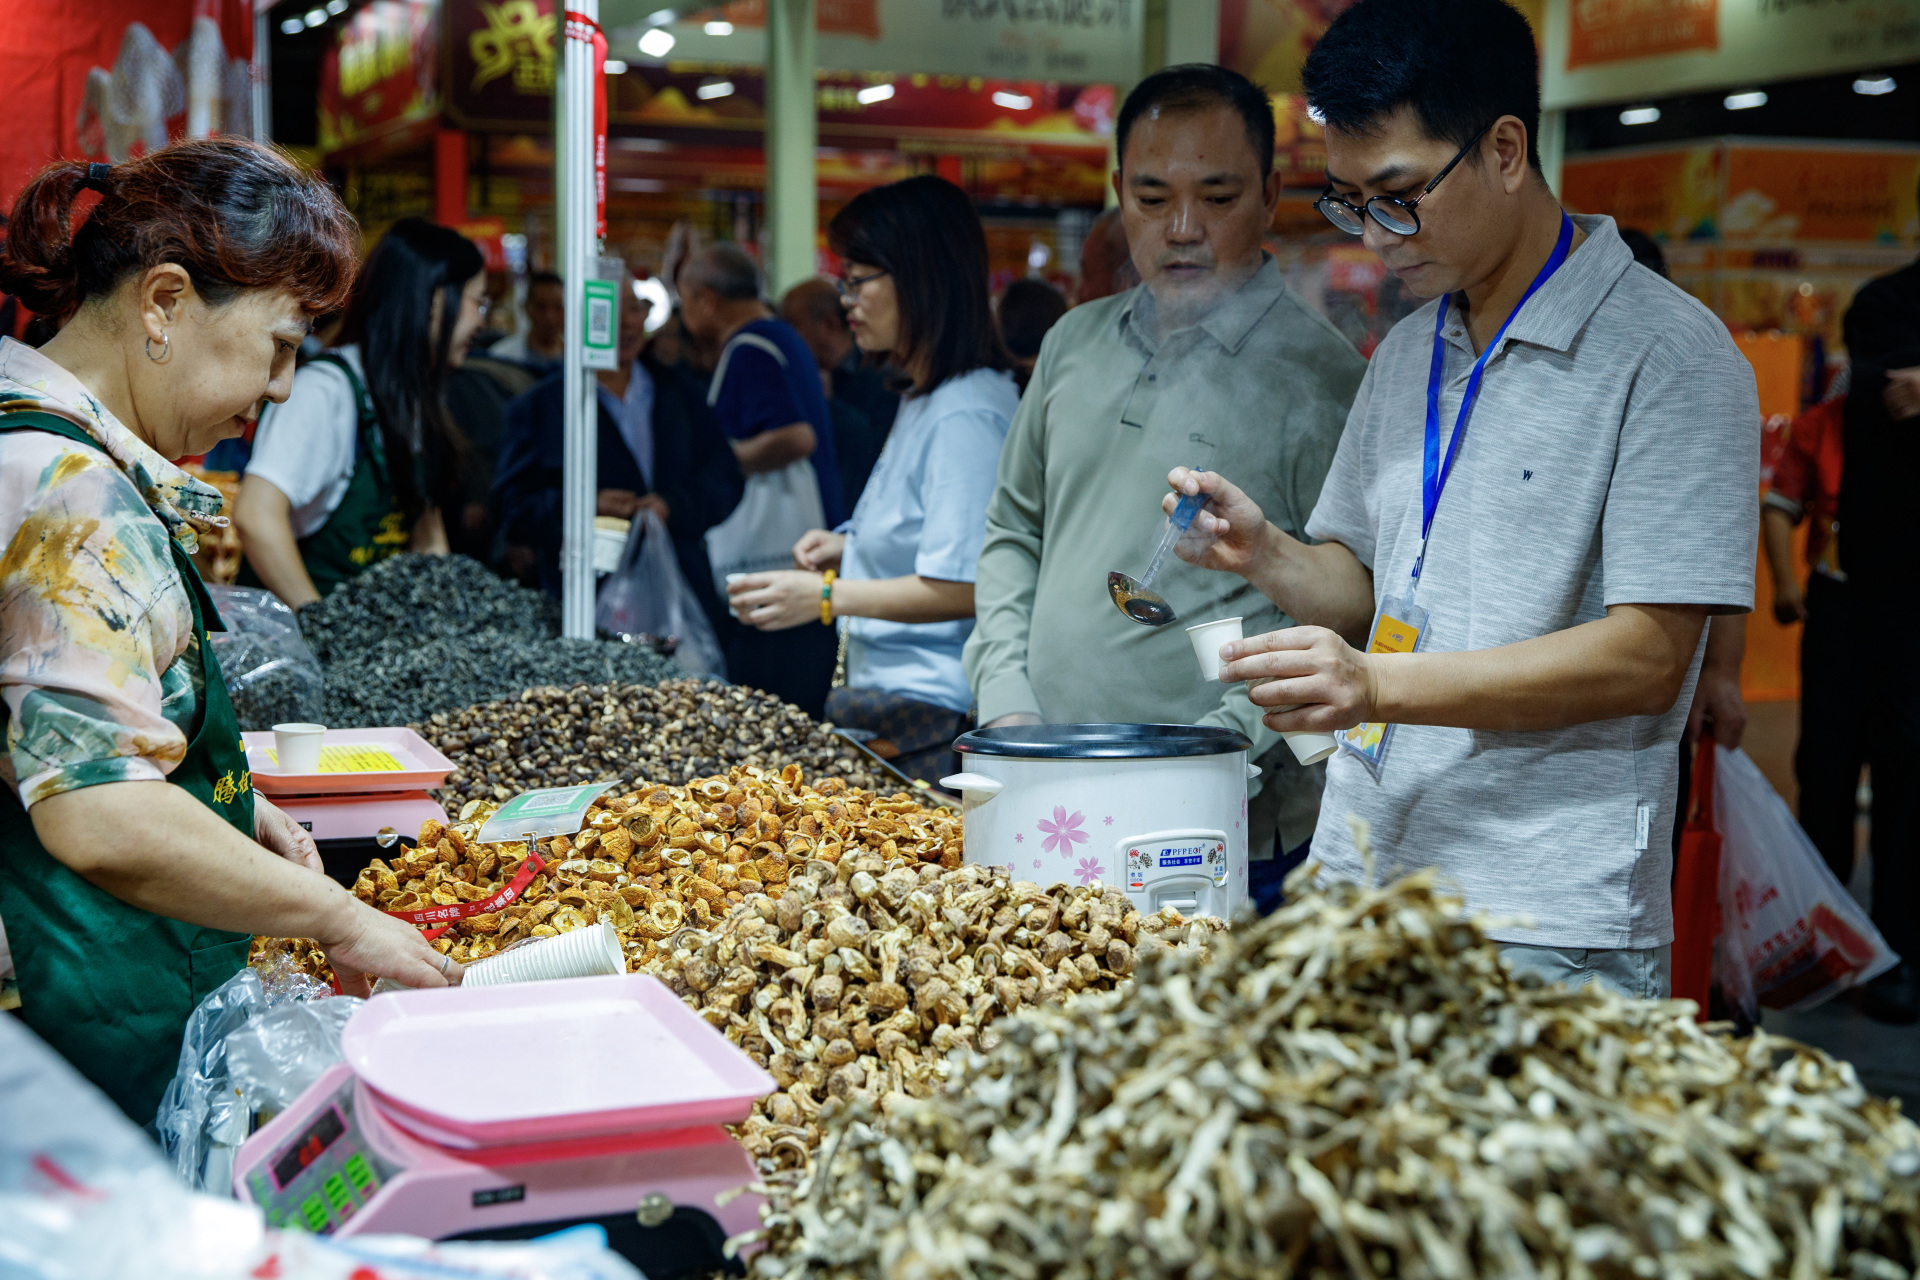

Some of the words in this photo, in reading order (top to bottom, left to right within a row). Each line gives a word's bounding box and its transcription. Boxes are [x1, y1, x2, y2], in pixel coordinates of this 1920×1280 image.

[1523, 469, 1534, 481] W
[413, 906, 461, 923] 四川名牌
